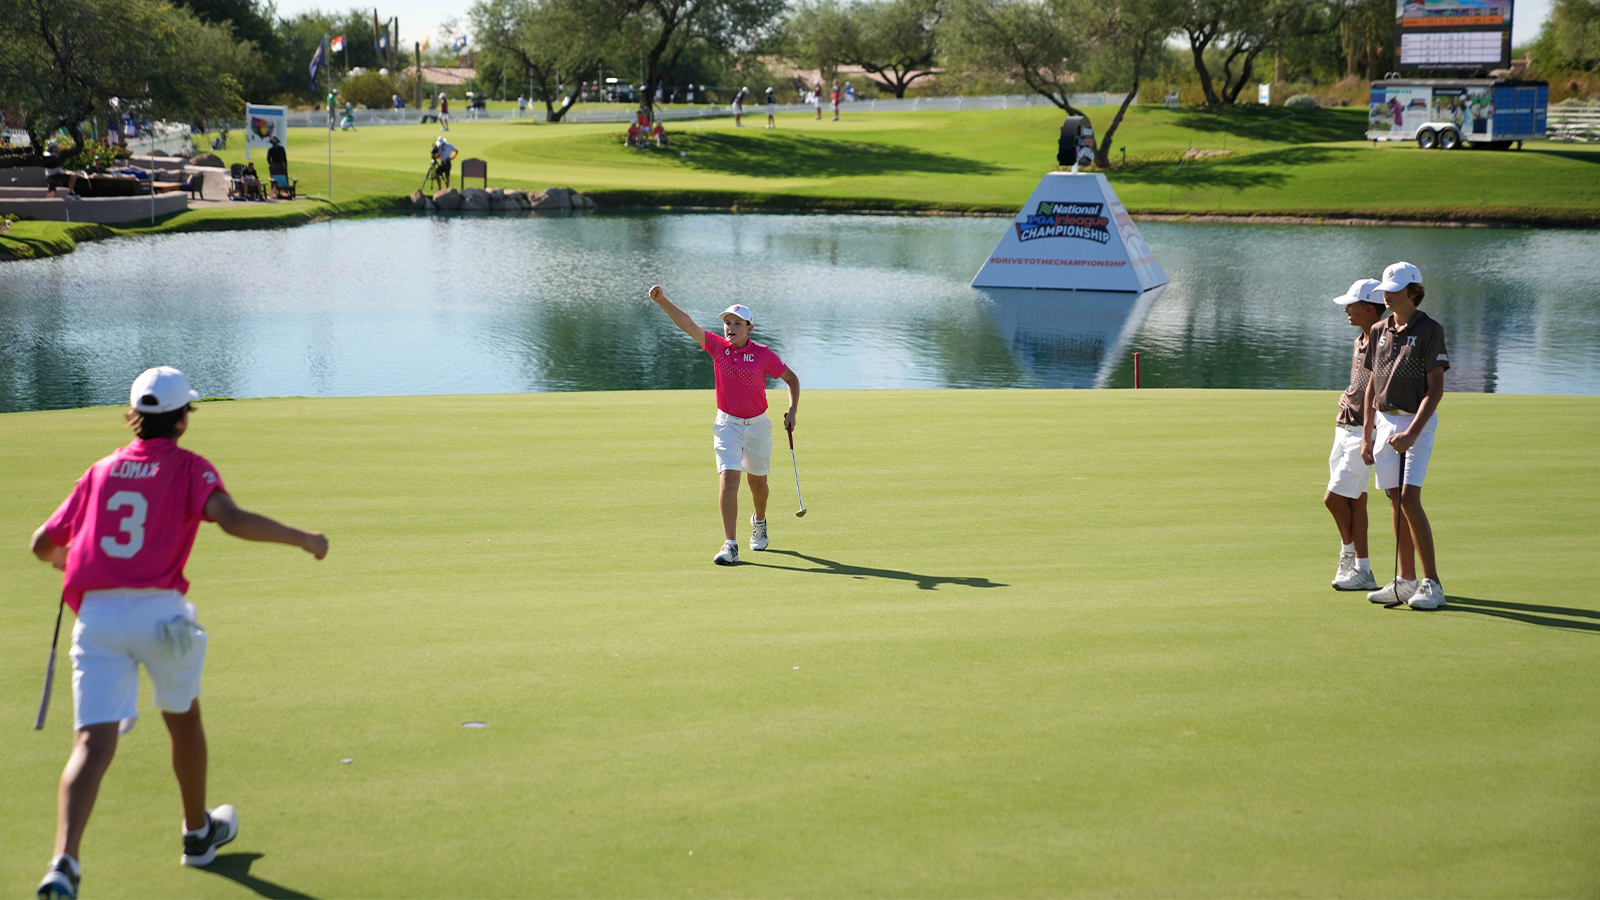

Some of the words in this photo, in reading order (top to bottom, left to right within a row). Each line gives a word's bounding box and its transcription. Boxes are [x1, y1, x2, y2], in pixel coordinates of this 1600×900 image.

[1052, 204, 1100, 215] National
[1028, 215, 1055, 225] PGA
[1020, 225, 1110, 242] CHAMPIONSHIP
[990, 257, 1127, 268] #DRIVETOTHECHAMPIONSHIP
[1379, 336, 1387, 347] 5
[1406, 336, 1418, 347] TX
[724, 348, 731, 356] 6
[743, 353, 755, 362] NC
[109, 460, 160, 480] LOMAX
[100, 490, 149, 559] 3
